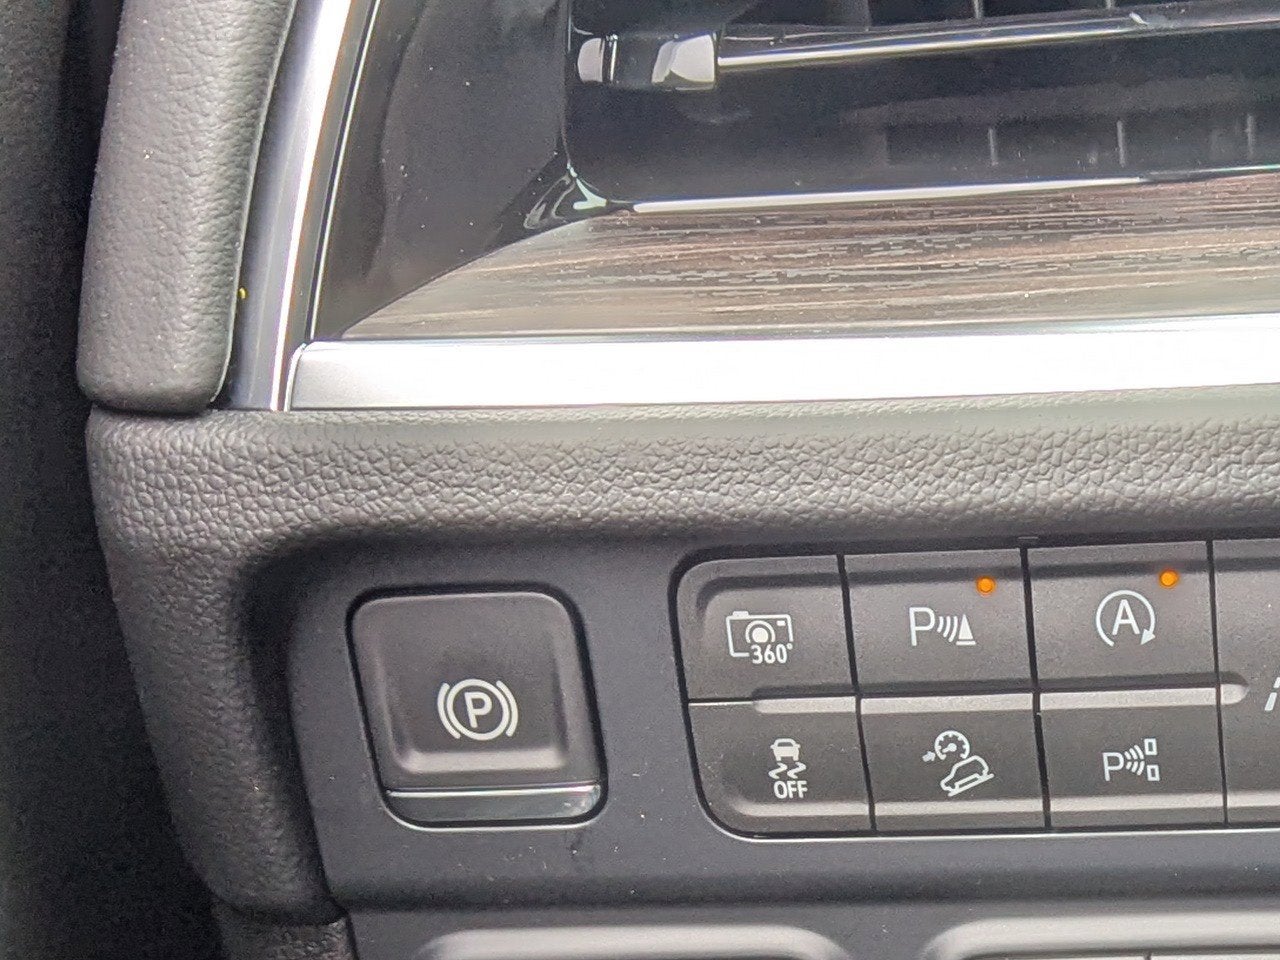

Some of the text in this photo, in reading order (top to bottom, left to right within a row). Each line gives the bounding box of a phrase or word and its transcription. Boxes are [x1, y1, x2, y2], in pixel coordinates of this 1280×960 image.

[908, 606, 935, 646] P
[1111, 598, 1141, 636] A
[463, 690, 493, 728] P
[1101, 751, 1125, 782] P
[773, 779, 808, 799] OFF
